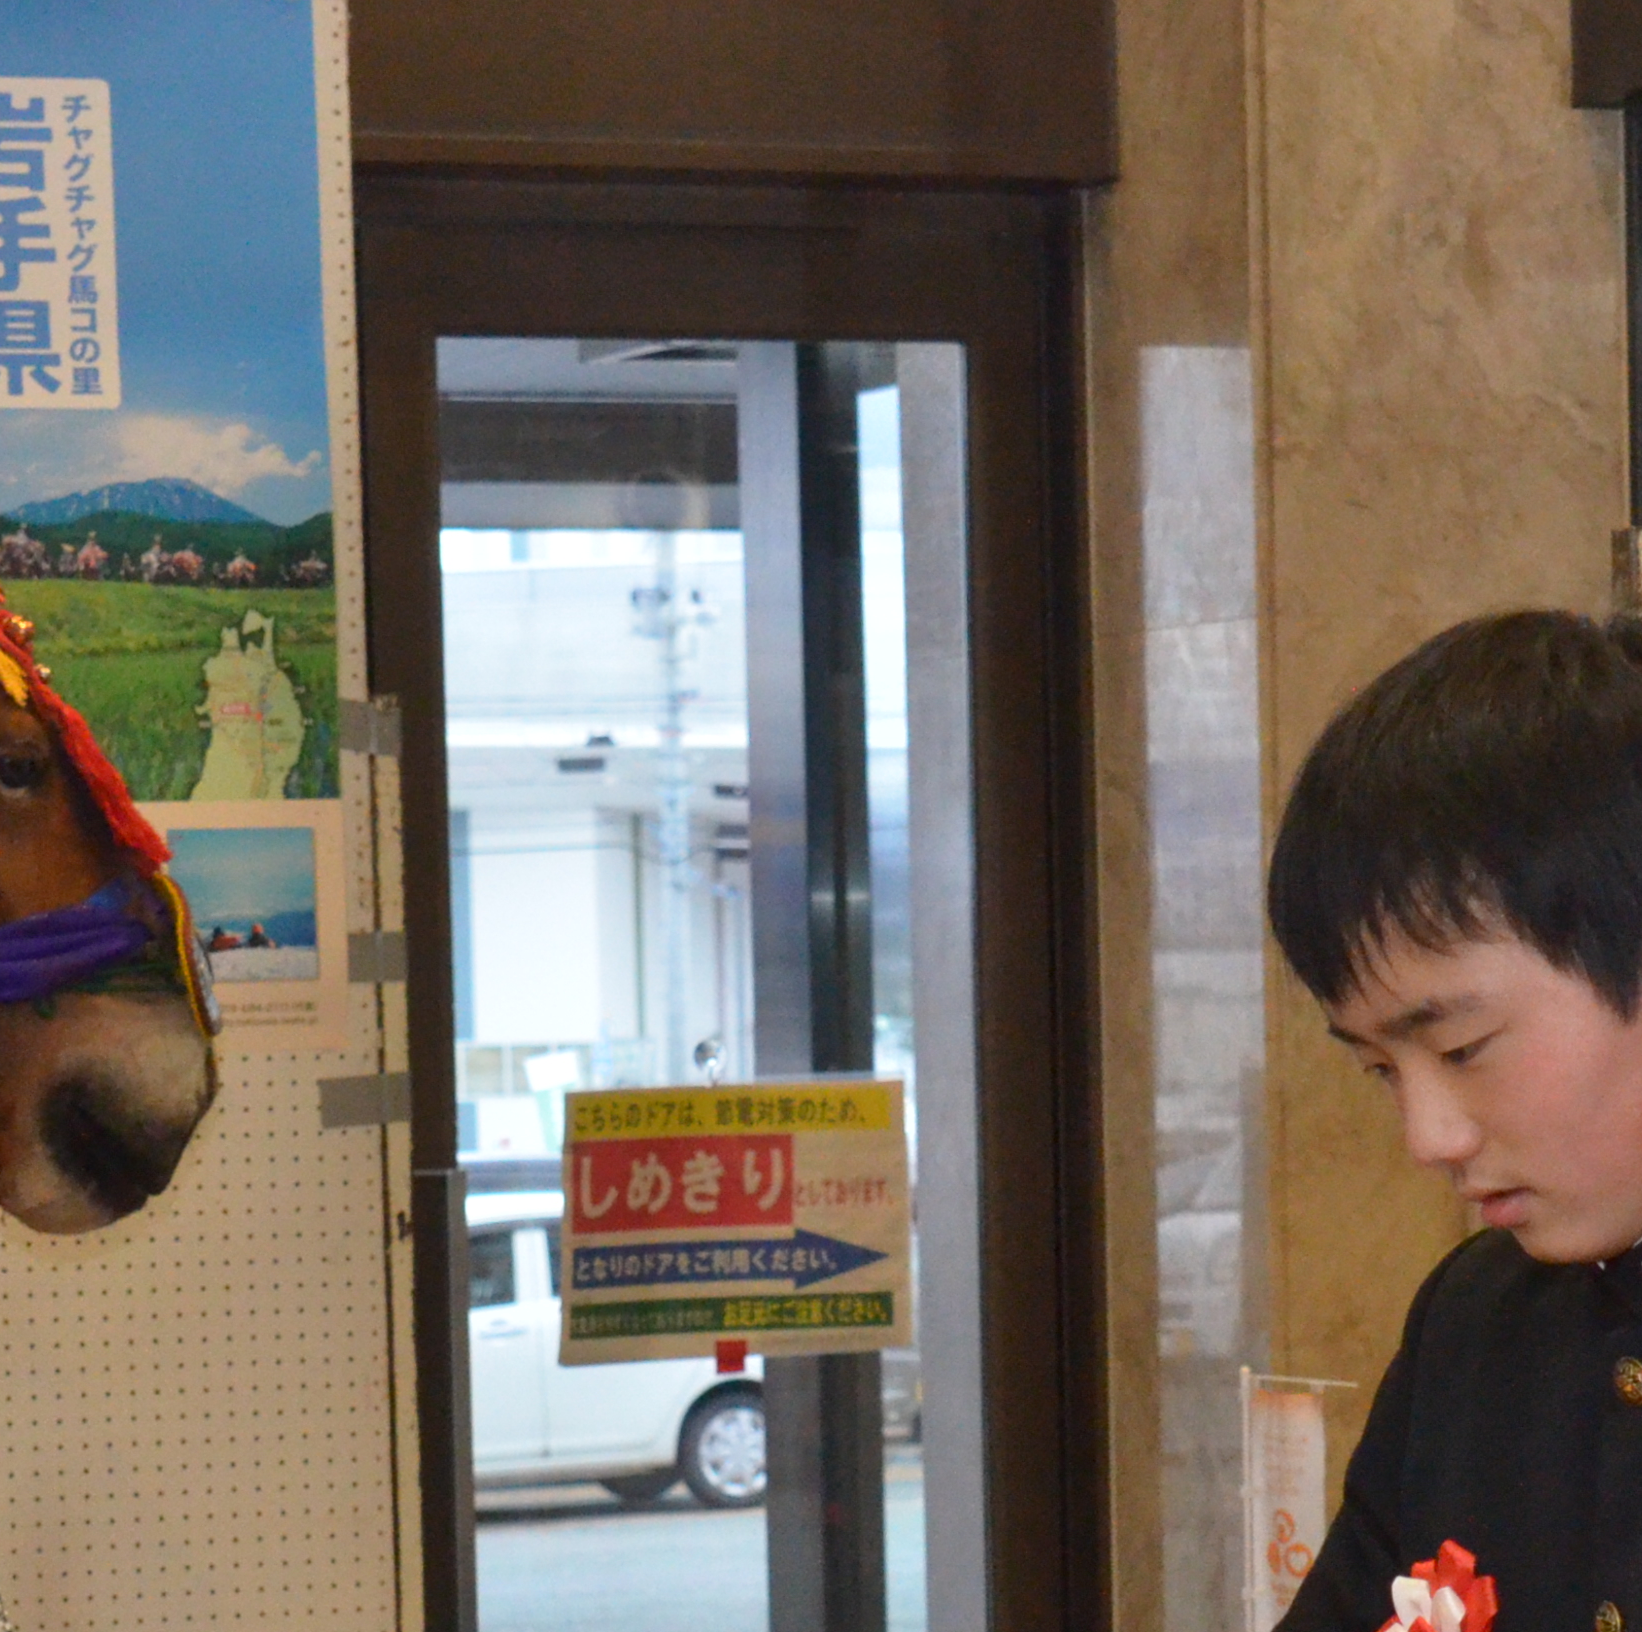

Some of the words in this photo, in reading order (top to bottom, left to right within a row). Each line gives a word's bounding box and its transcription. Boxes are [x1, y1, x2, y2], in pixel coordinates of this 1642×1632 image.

[61, 93, 104, 396] チャグチャグ馬コの里
[581, 1149, 785, 1219] しめきり
